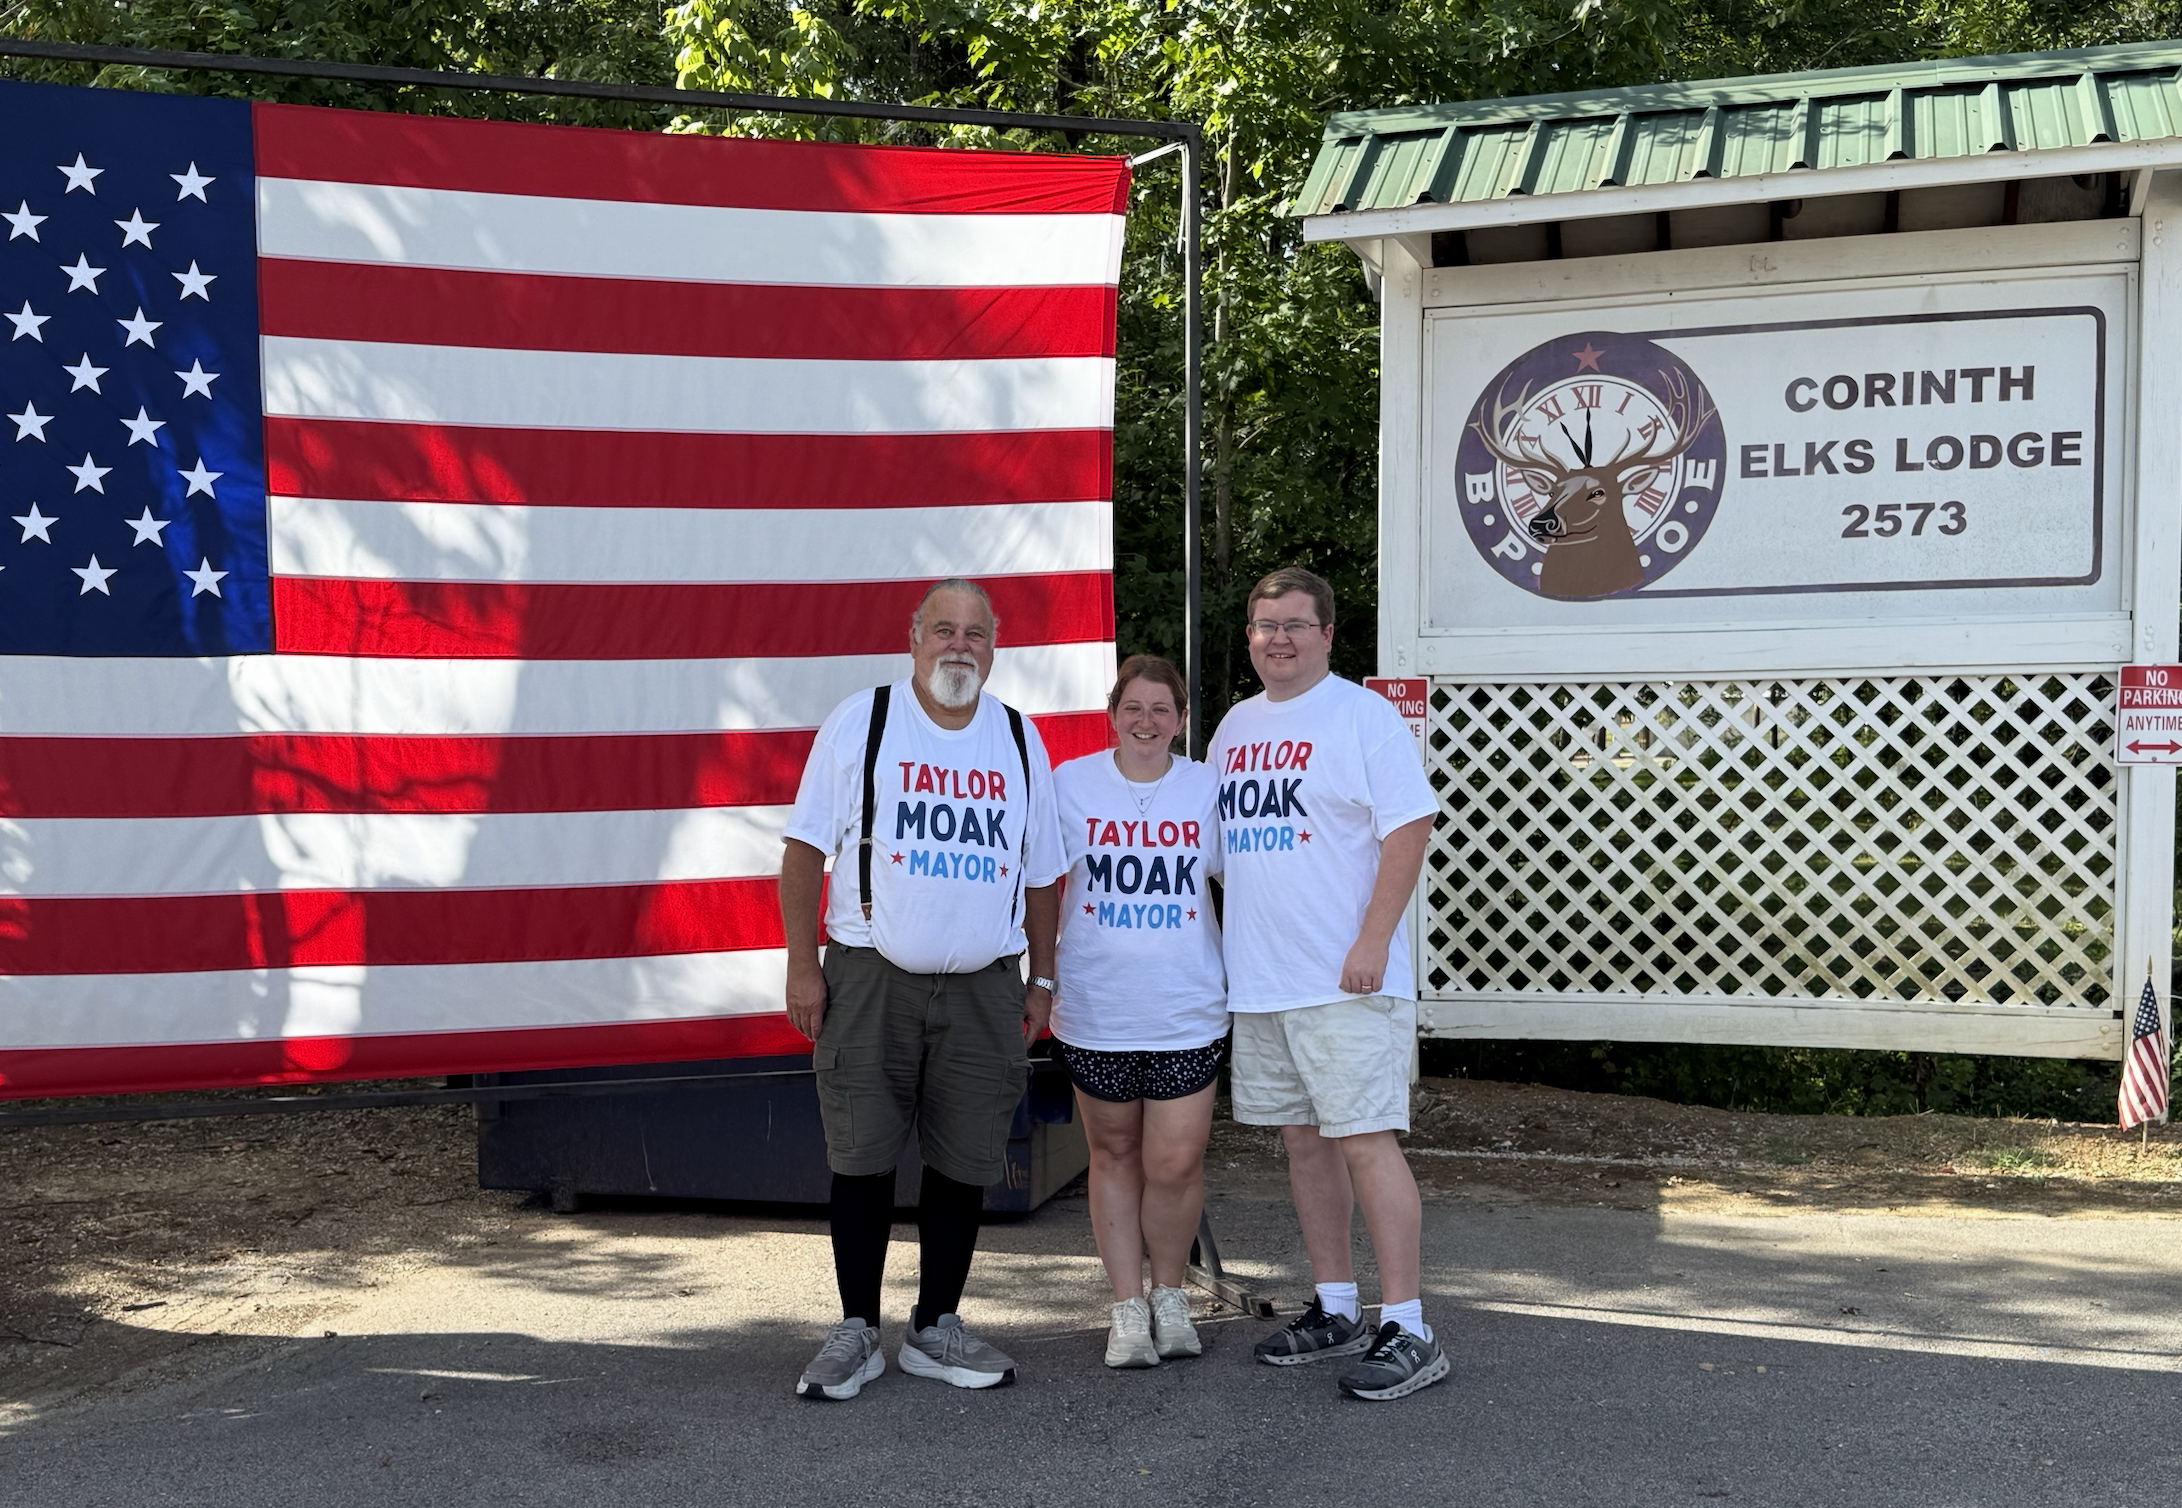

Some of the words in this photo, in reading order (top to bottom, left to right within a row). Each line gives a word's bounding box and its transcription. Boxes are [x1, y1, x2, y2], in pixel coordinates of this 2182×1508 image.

[1785, 366, 2035, 412] CORINTH
[1741, 439, 1875, 478] ELKS
[1896, 431, 2083, 471] LODGE
[1842, 501, 1967, 538] 2573
[1387, 683, 1406, 698] NO
[2145, 670, 2168, 686] NO
[2123, 689, 2182, 706] PARKIN
[1225, 740, 1313, 776] TAYLOR
[899, 761, 1006, 801] TAYLOR
[1218, 778, 1308, 821] MOAK
[896, 801, 1009, 850] MOAK
[1086, 818, 1200, 849] TAYLOR
[1227, 826, 1294, 854] MAYOR
[909, 850, 995, 883] MAYOR
[1086, 854, 1198, 895] MOAK
[1099, 901, 1181, 929] MAYOR
